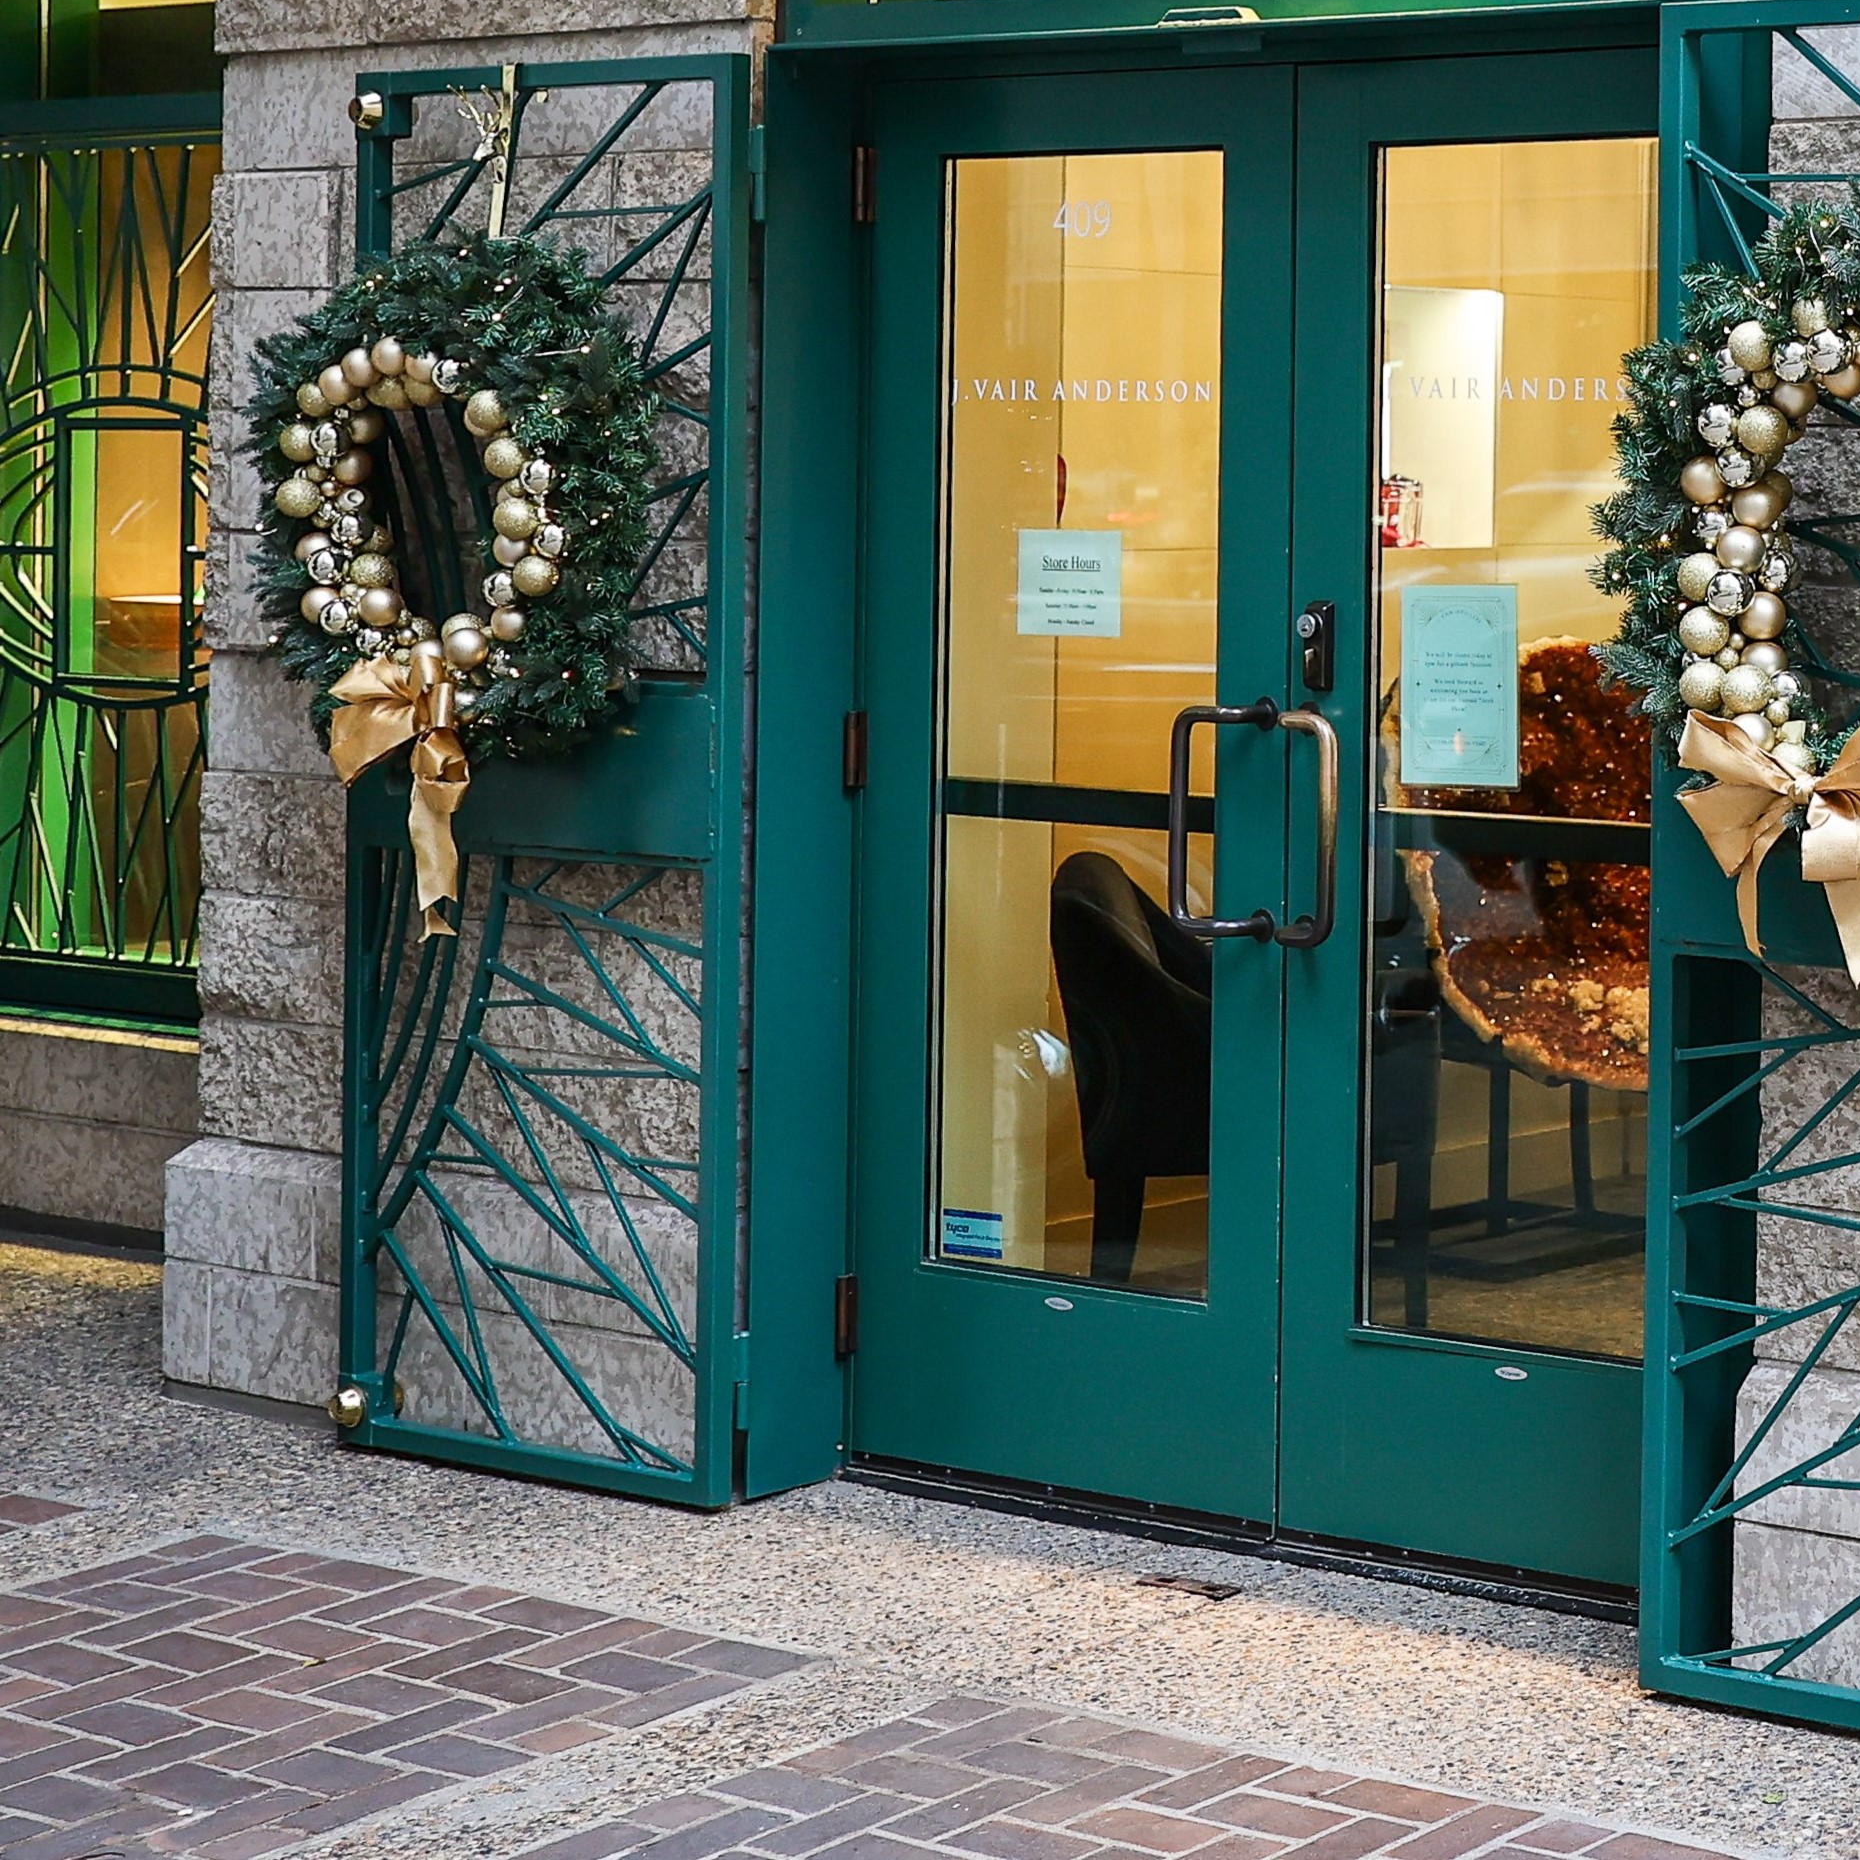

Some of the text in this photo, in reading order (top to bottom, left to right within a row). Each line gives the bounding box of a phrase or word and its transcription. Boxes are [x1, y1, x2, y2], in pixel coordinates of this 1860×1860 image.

[1052, 200, 1112, 239] 409
[951, 378, 1212, 407] J.VAIR ANDERSON
[1042, 555, 1101, 570] Store Hours
